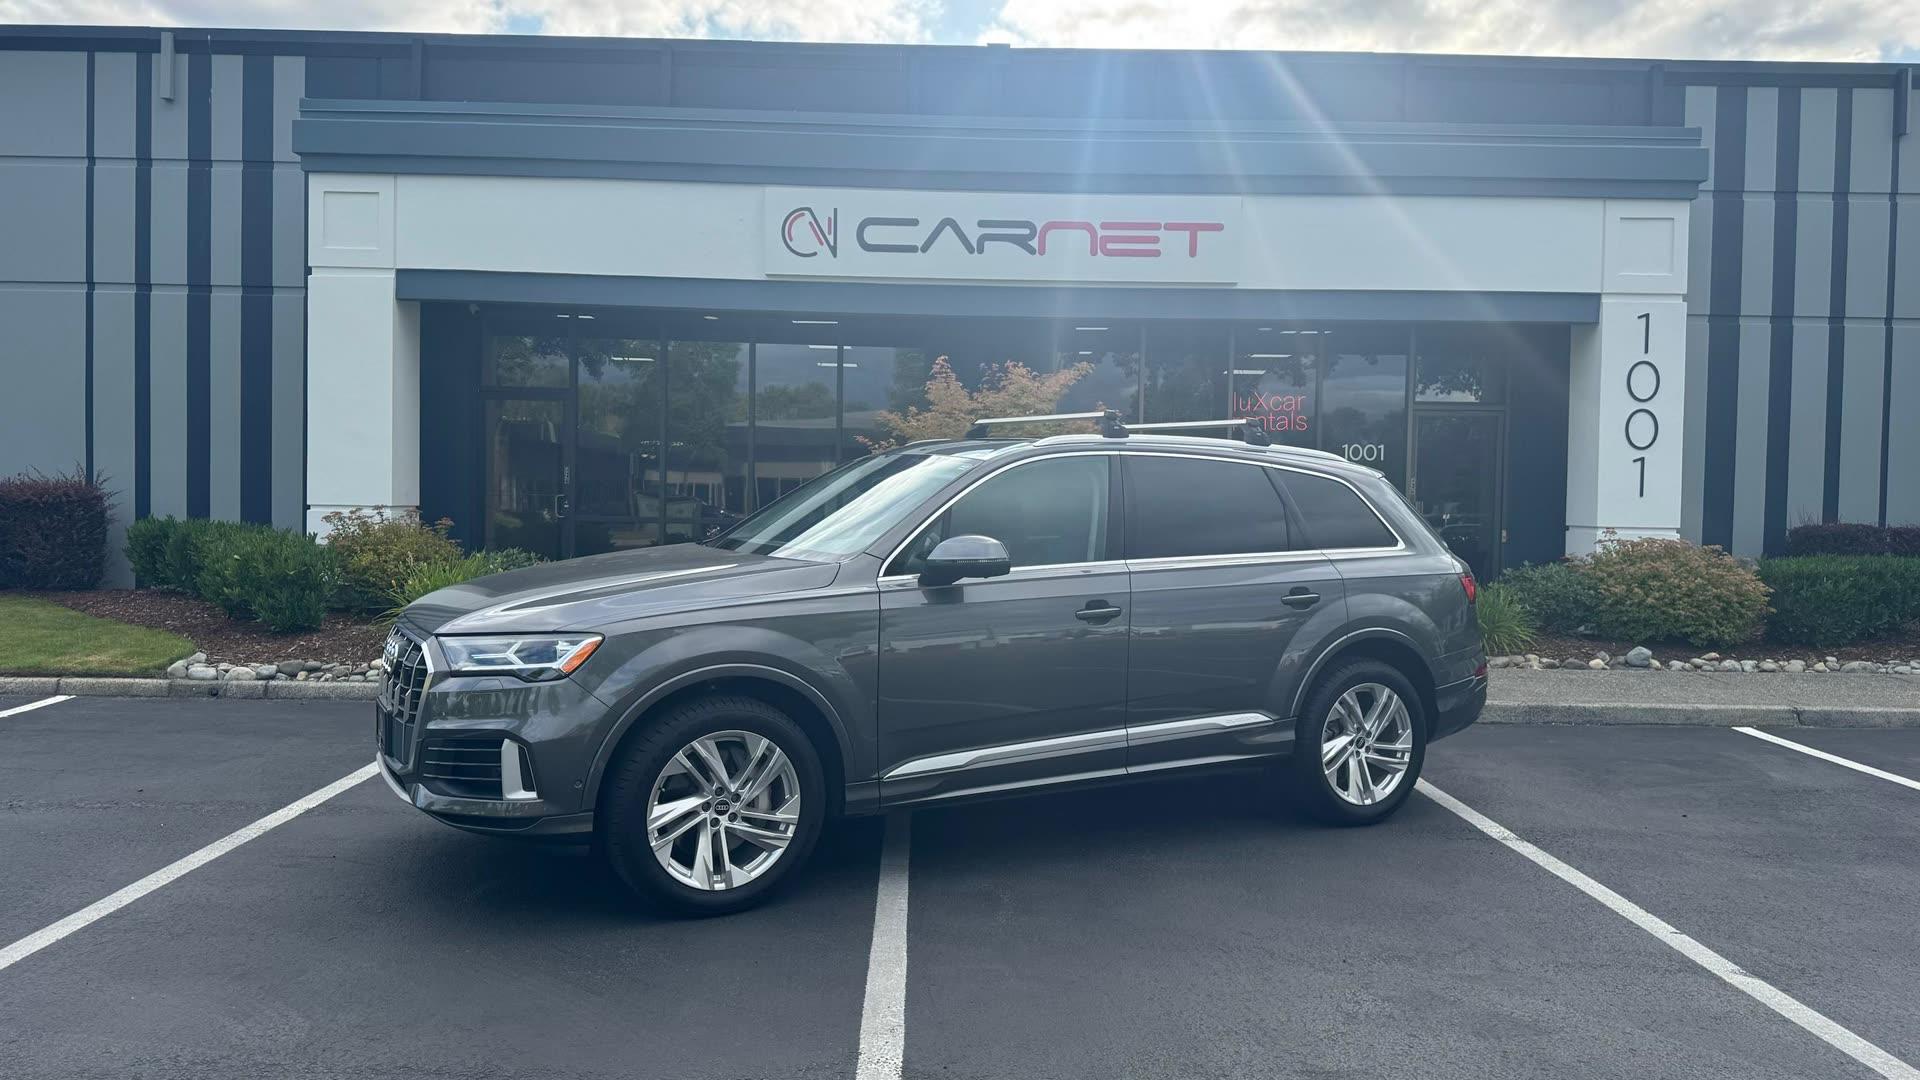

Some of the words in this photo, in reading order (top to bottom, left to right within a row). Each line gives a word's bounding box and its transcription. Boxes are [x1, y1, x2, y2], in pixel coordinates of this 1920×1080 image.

[856, 216, 1225, 258] CARNET
[1232, 391, 1307, 412] luXcar
[1624, 312, 1661, 498] 1001
[1232, 411, 1308, 431] ntals
[1341, 443, 1385, 462] 1001
